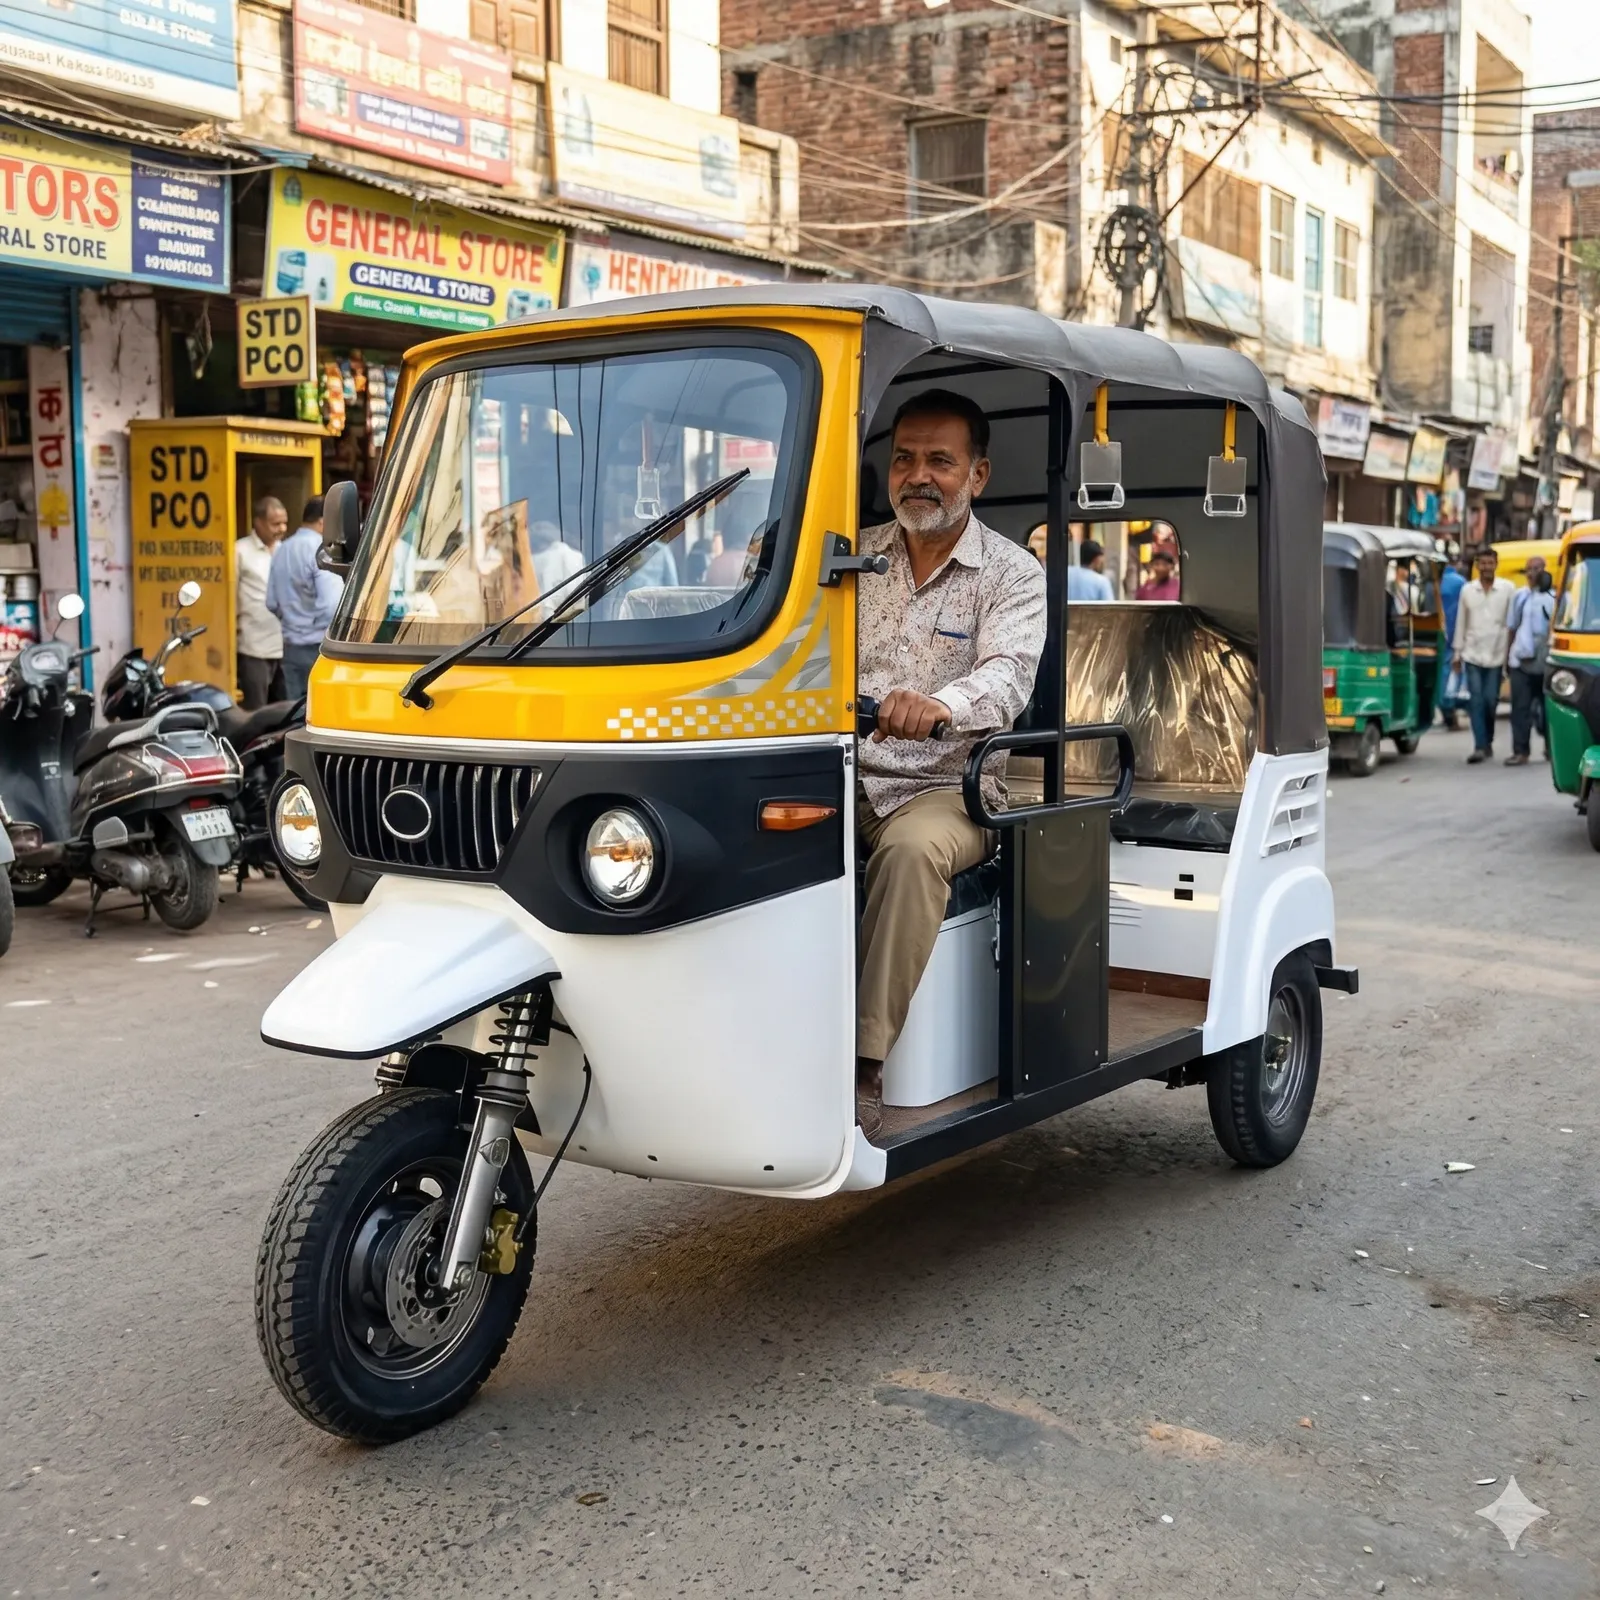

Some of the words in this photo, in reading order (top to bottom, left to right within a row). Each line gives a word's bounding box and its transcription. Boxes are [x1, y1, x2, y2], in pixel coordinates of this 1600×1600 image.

[0, 158, 120, 228] TORS
[44, 232, 107, 260] STORE
[305, 198, 447, 267] GENERAL
[457, 230, 546, 283] STORE
[355, 265, 434, 294] GENERAL
[437, 279, 491, 303] STORE
[245, 307, 302, 339] STD
[245, 343, 304, 376] PCO
[150, 445, 208, 482] STD
[150, 491, 212, 529] PCO
